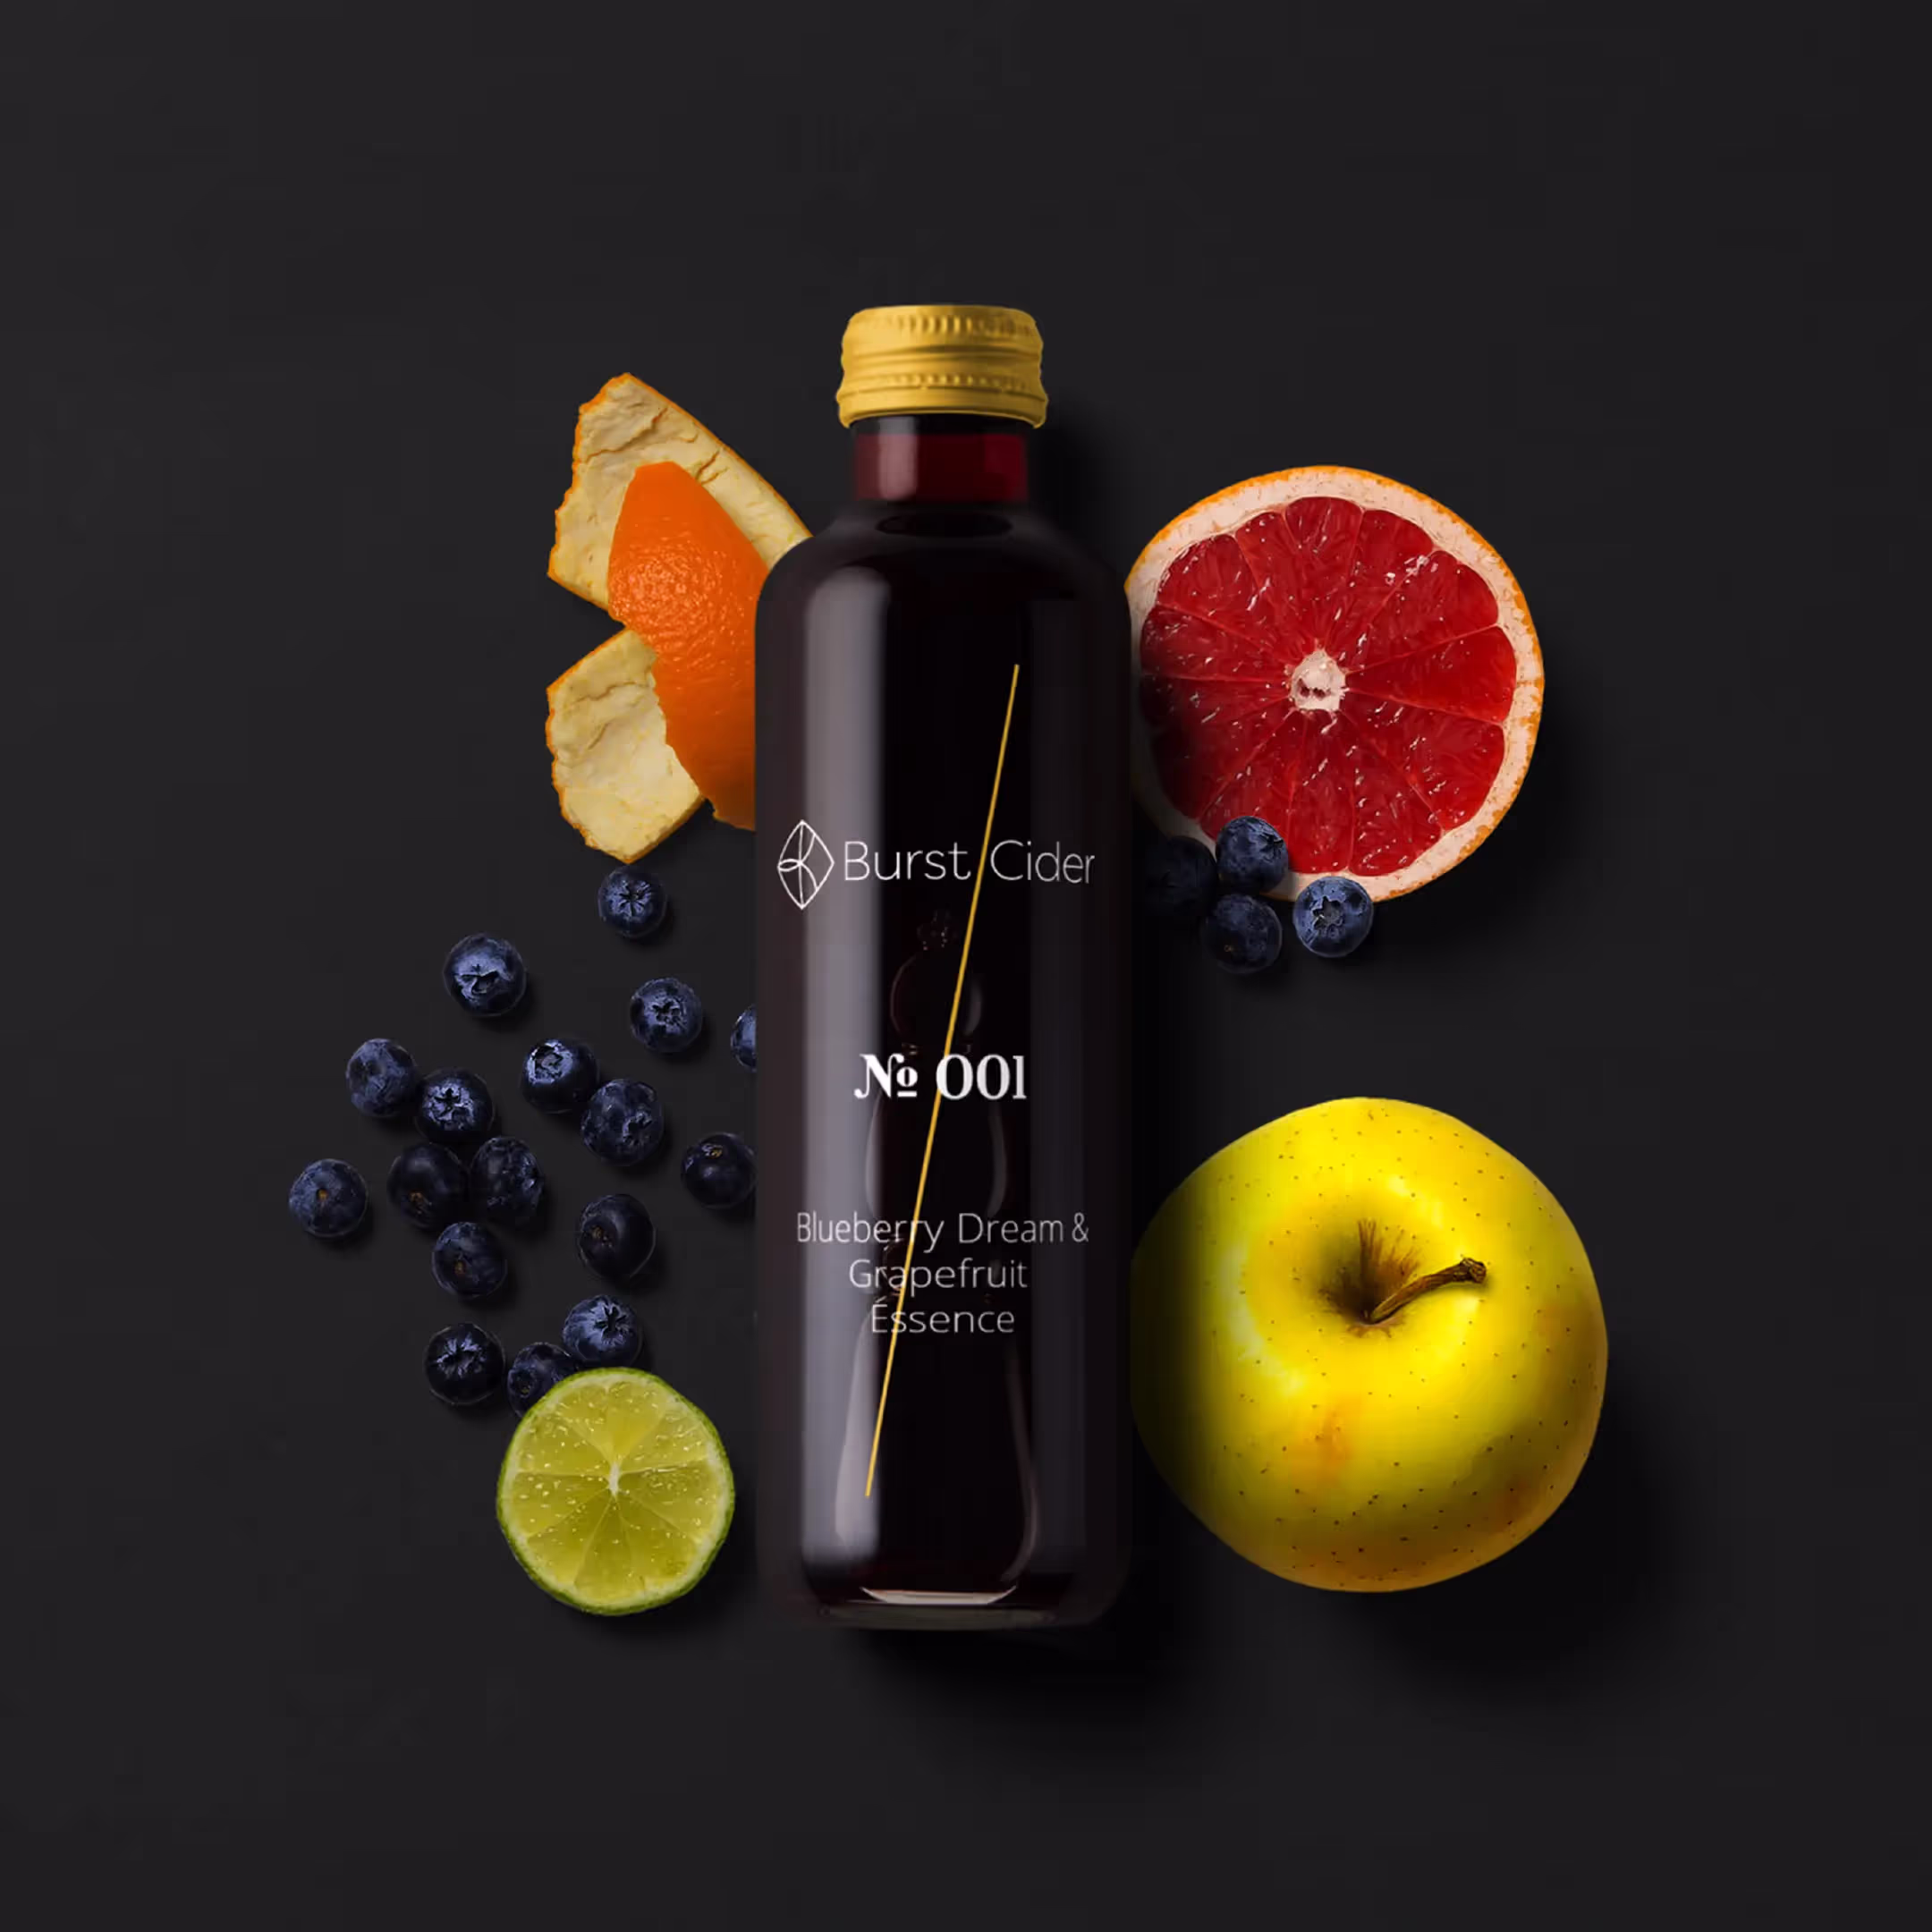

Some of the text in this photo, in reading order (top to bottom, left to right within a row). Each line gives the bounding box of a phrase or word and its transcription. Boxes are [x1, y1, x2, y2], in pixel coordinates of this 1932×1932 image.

[843, 839, 1096, 884] Burst Cider
[936, 1054, 1028, 1101] 001
[796, 1210, 1089, 1253] Blueberry Dream &
[849, 1258, 1029, 1297] Grapefruit
